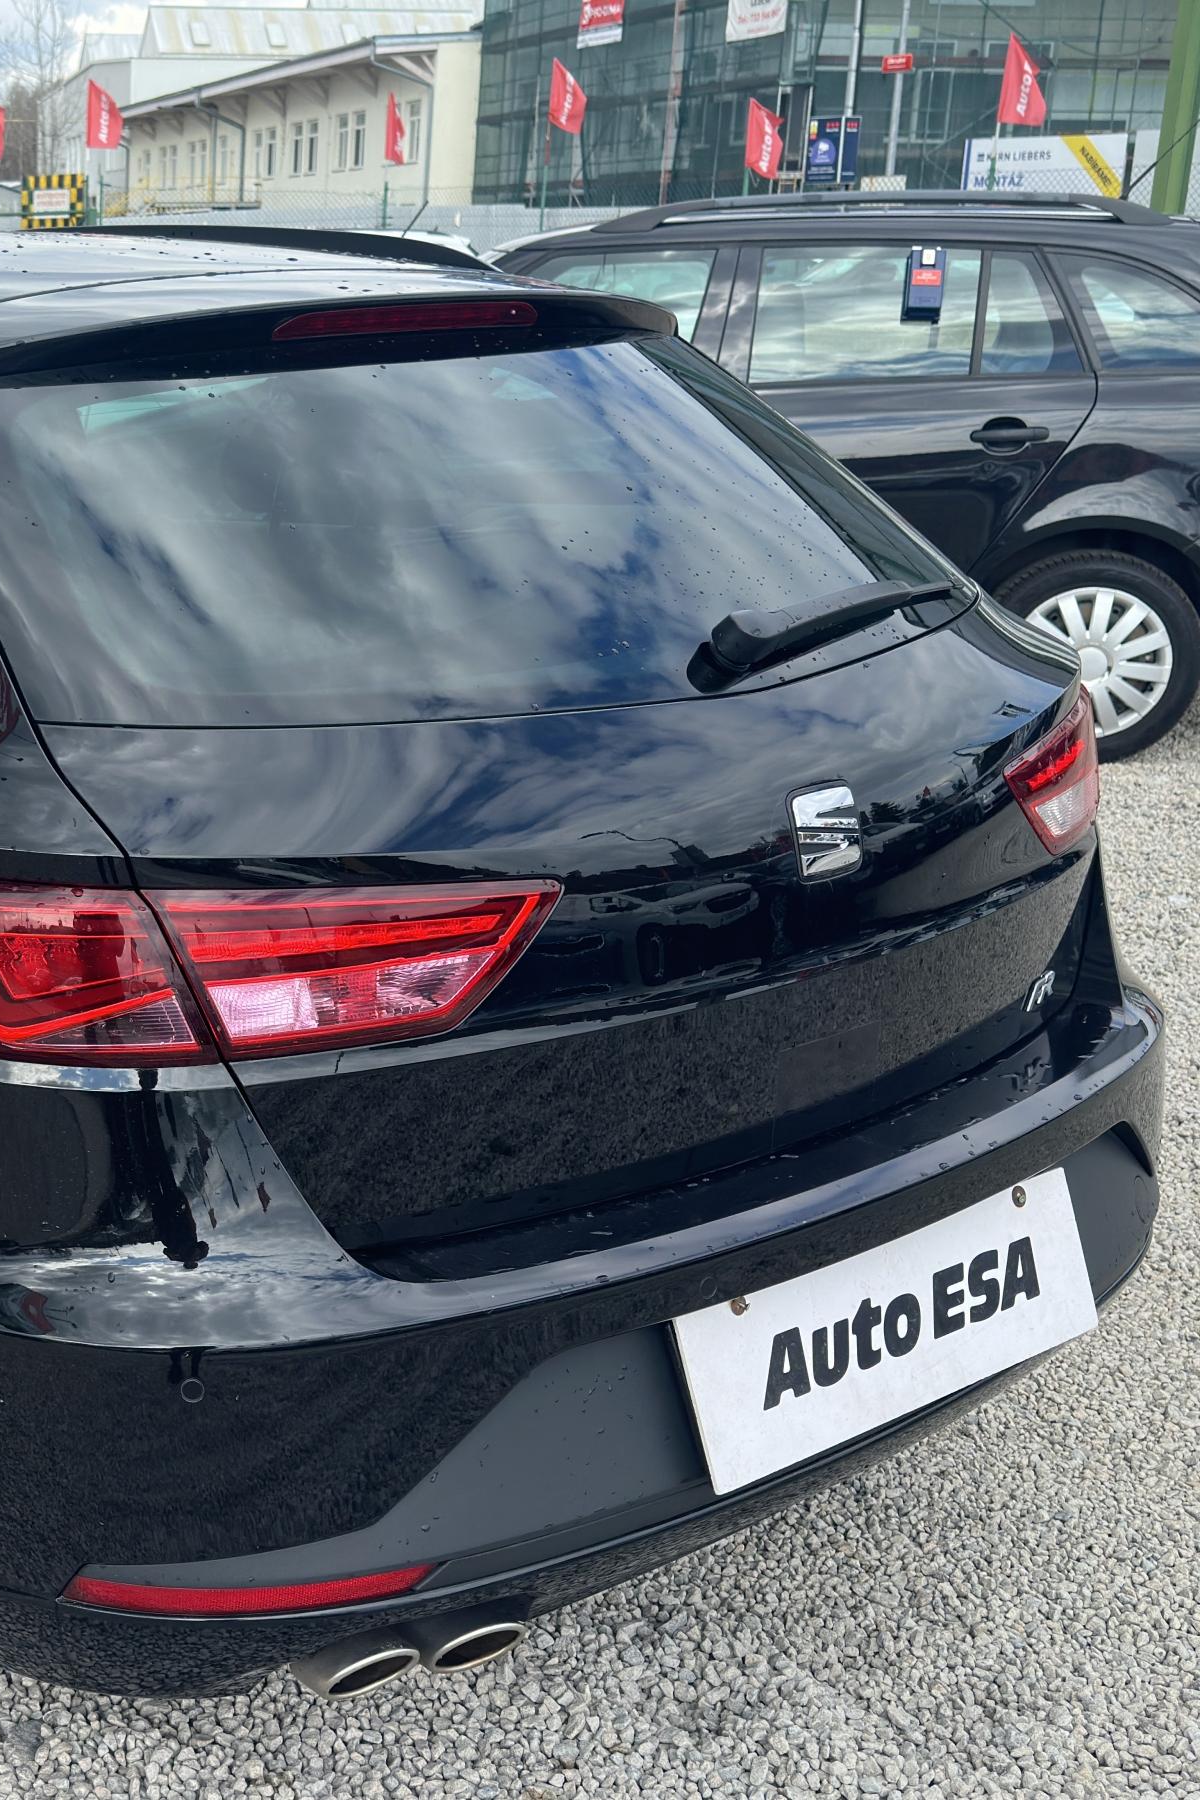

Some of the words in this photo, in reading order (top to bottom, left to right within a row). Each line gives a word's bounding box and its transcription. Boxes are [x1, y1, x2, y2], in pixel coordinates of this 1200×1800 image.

[1015, 76, 1033, 117] Auto
[97, 112, 110, 144] Auto
[758, 135, 773, 172] Auto
[986, 152, 1011, 163] KRN
[1012, 150, 1052, 163] LIEBERS
[763, 1293, 922, 1411] Auto
[932, 1236, 1041, 1340] ESA
